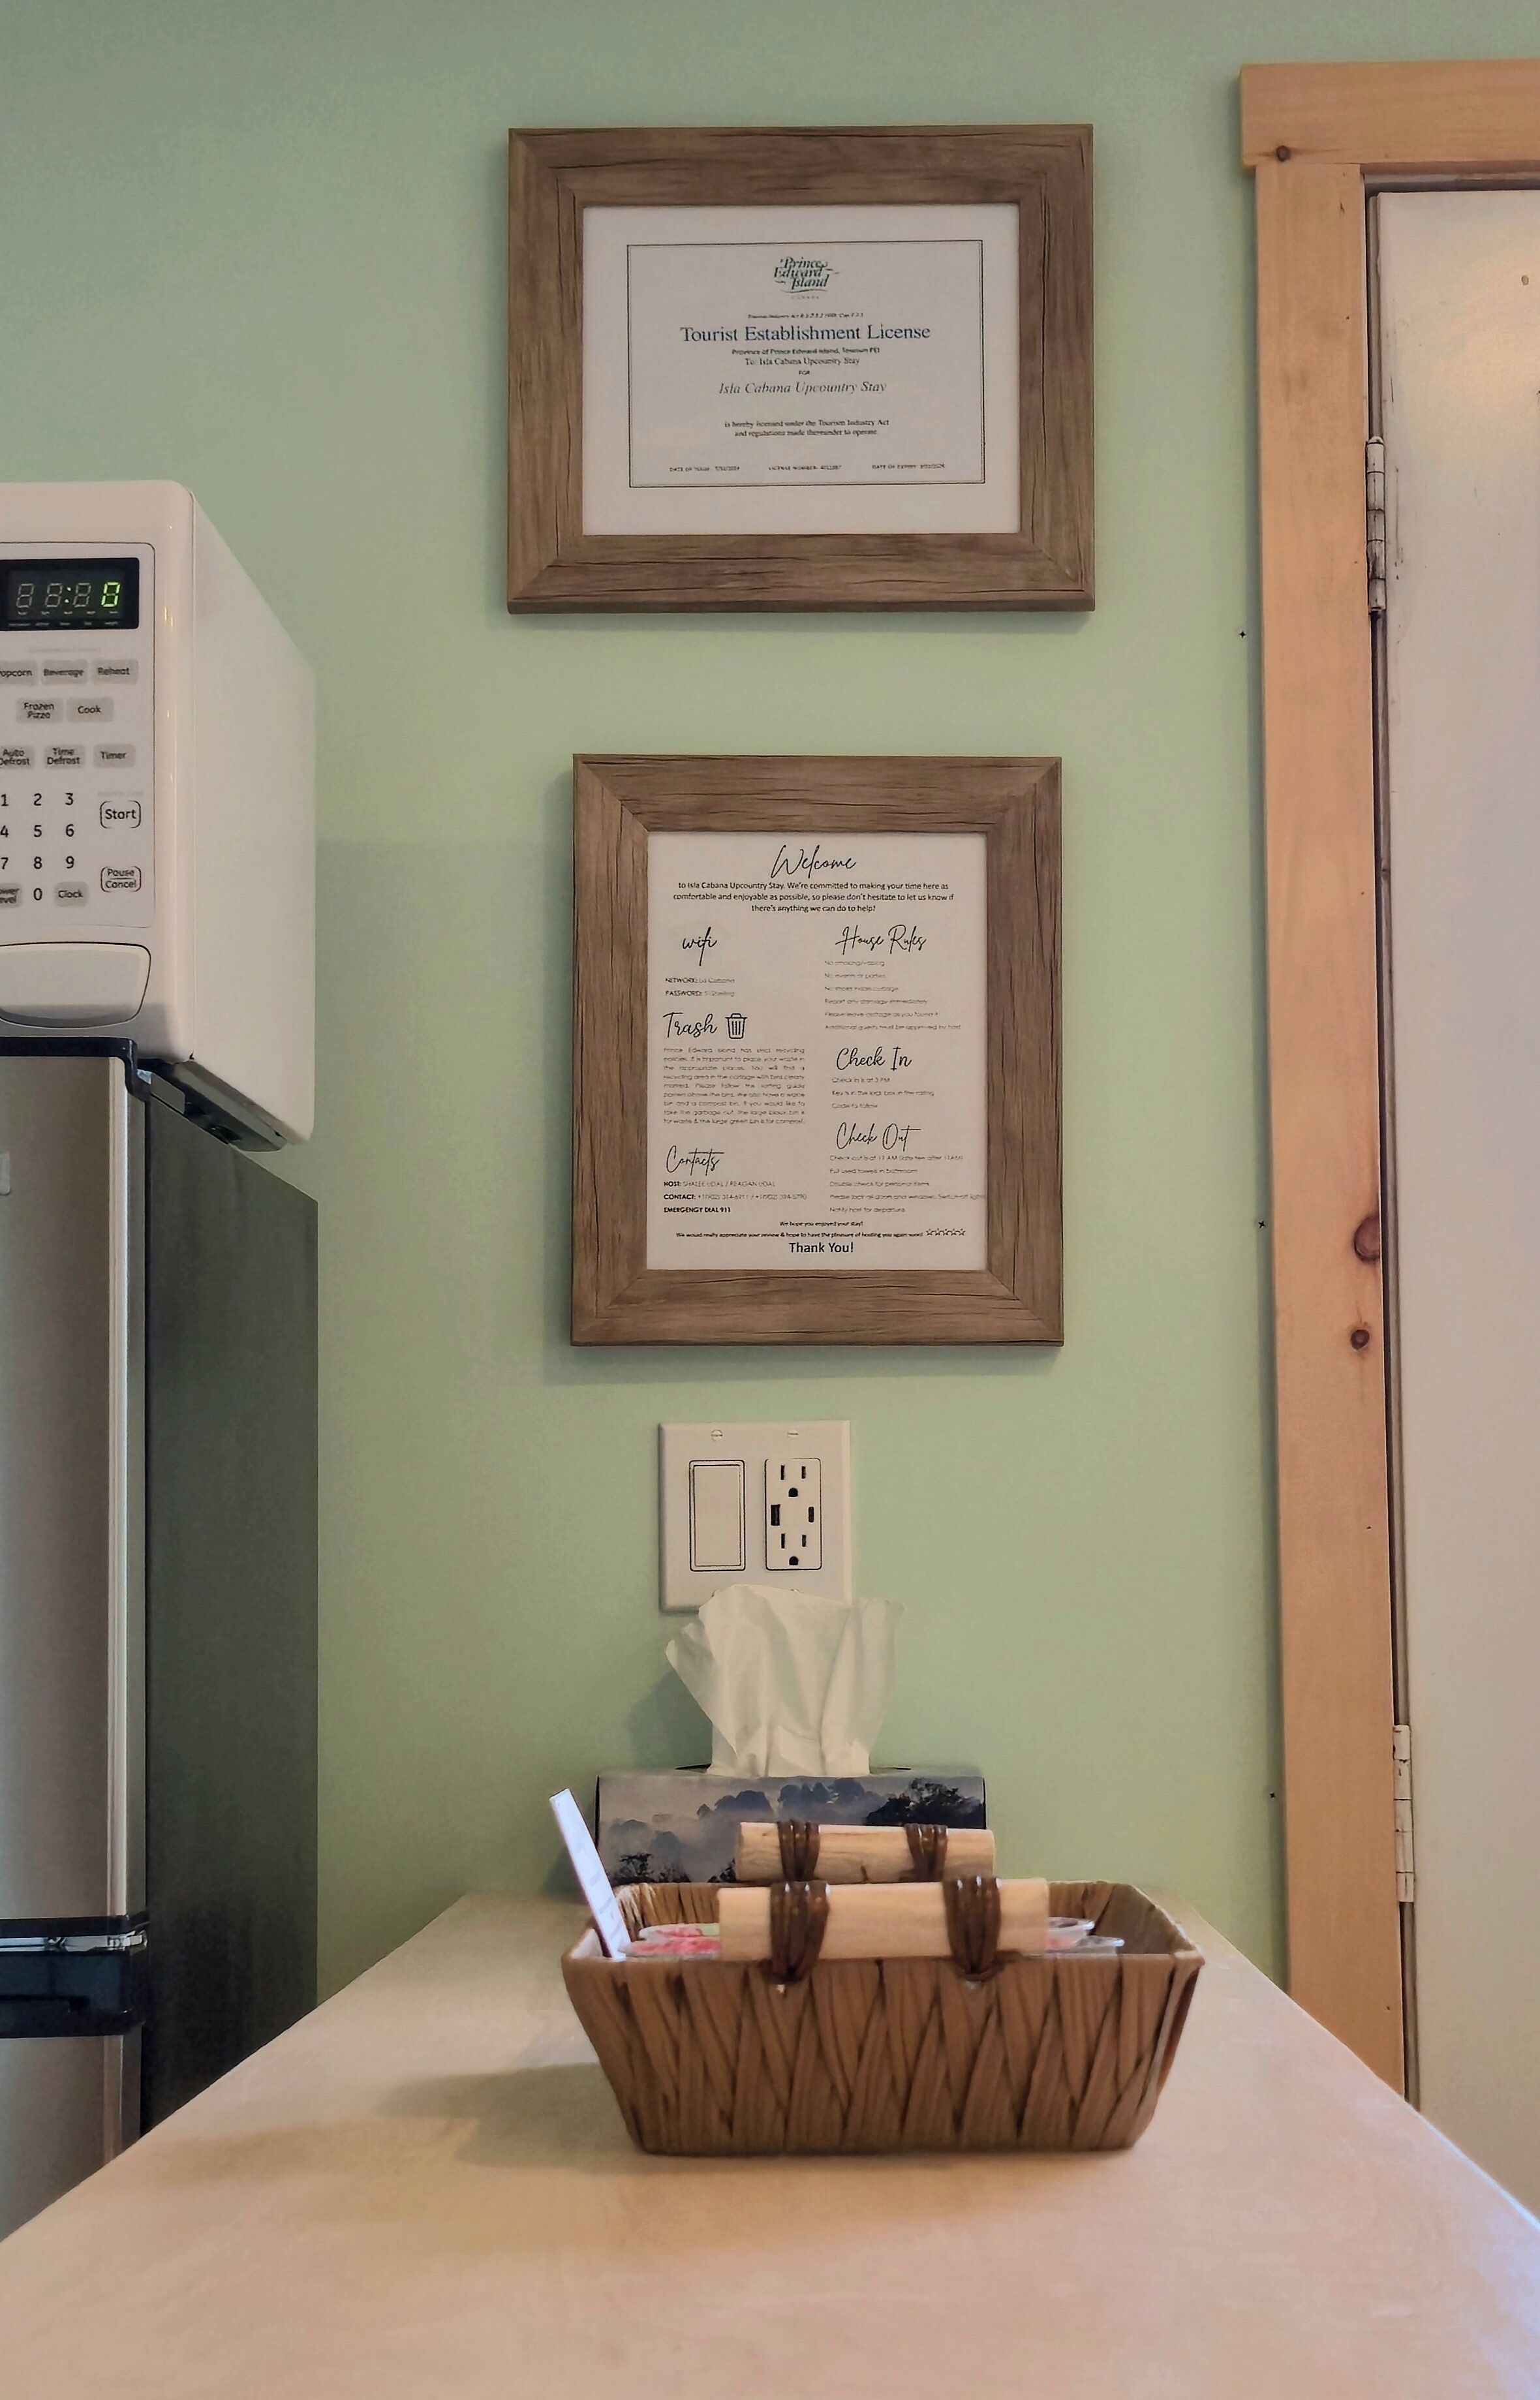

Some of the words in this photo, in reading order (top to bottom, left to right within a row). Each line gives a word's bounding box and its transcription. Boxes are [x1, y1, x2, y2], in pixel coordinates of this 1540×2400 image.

[780, 256, 827, 268] Prince
[774, 265, 824, 278] Edward
[790, 274, 829, 290] Island
[681, 327, 738, 343] Tourist
[745, 325, 860, 341] Establishment
[867, 324, 931, 339] License
[720, 383, 740, 393] Isla
[745, 382, 790, 393] Cabana
[796, 381, 857, 395] Upcountry
[861, 381, 886, 391] Stay
[97, 668, 130, 676] Reheat
[24, 702, 54, 711] Frozen
[78, 705, 101, 714] Cook
[46, 756, 80, 765] Defrost
[100, 751, 127, 760] Timer
[1, 793, 8, 807] 1
[33, 793, 42, 806] 2
[65, 792, 74, 805] 3
[105, 808, 137, 820] Start
[0, 825, 9, 838] 4
[33, 824, 42, 837] 5
[65, 823, 74, 837] 6
[1, 857, 8, 870] 7
[33, 856, 42, 869] 8
[65, 855, 74, 869] 9
[771, 844, 857, 878] Welcome
[107, 868, 134, 876] Pause
[105, 880, 136, 888] Cancel
[33, 887, 42, 900] 0
[683, 927, 717, 966] wifi
[835, 925, 884, 955] House
[888, 924, 927, 954] Rules
[662, 1012, 718, 1038] Trash
[837, 1046, 886, 1070] Check
[890, 1046, 912, 1071] In
[837, 1122, 877, 1149] Check
[882, 1123, 921, 1152] Out
[666, 1145, 725, 1176] Contacts
[789, 1242, 824, 1252] Thank
[829, 1242, 853, 1252] You!
